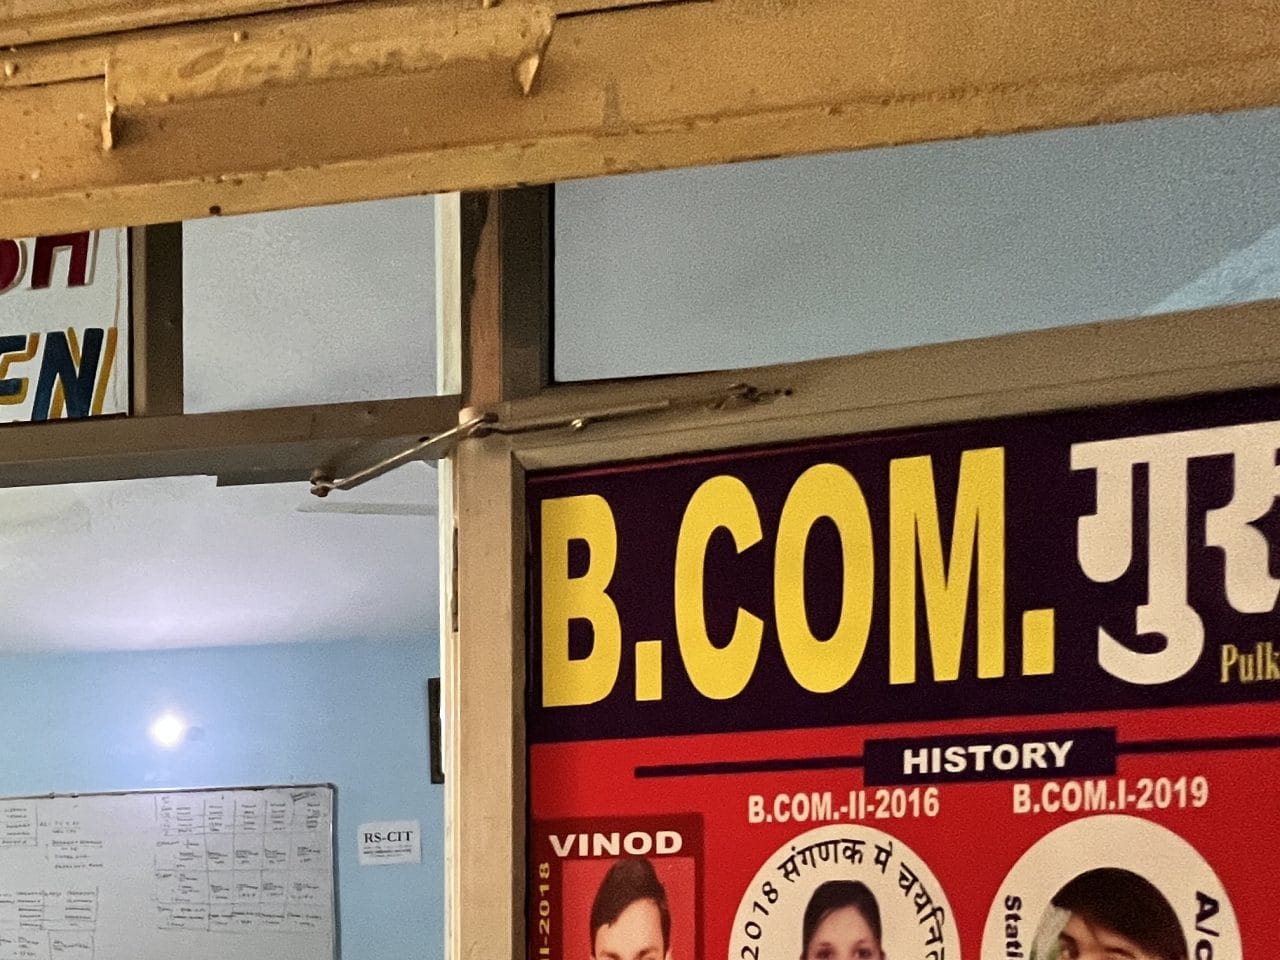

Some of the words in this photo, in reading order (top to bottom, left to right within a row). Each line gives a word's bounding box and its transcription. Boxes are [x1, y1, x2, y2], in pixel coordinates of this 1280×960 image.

[540, 446, 1055, 708] B.COM.
[902, 741, 1074, 775] HISTORY
[748, 787, 940, 824] B.COM.-II-2016
[1013, 777, 1209, 815] B.COM.I-2019
[364, 831, 414, 843] RS-CIT
[549, 831, 683, 857] VINOD
